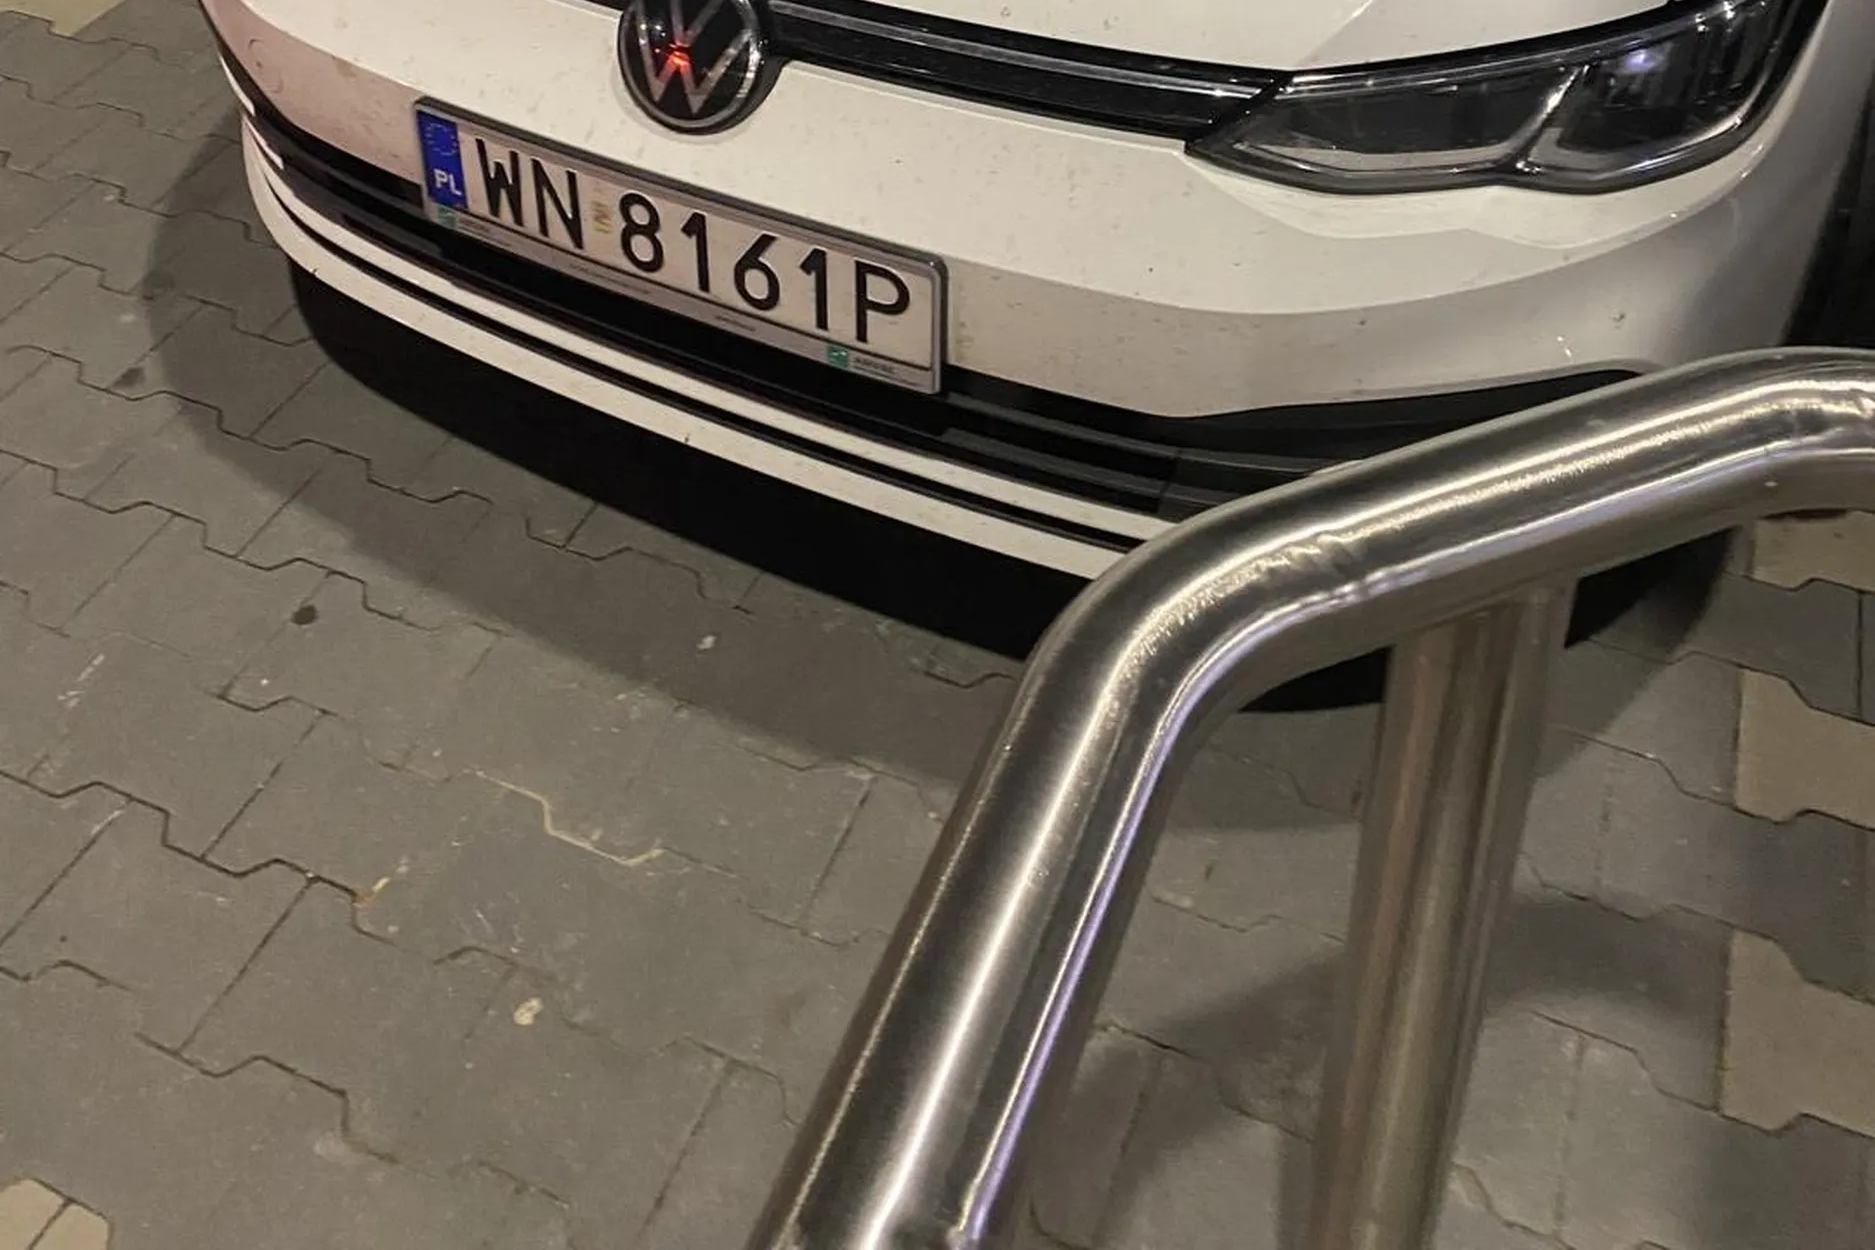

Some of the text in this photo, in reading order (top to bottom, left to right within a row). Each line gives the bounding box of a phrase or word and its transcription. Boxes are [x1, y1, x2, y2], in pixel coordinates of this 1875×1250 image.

[433, 168, 463, 196] PL
[475, 138, 911, 344] WN 8161P
